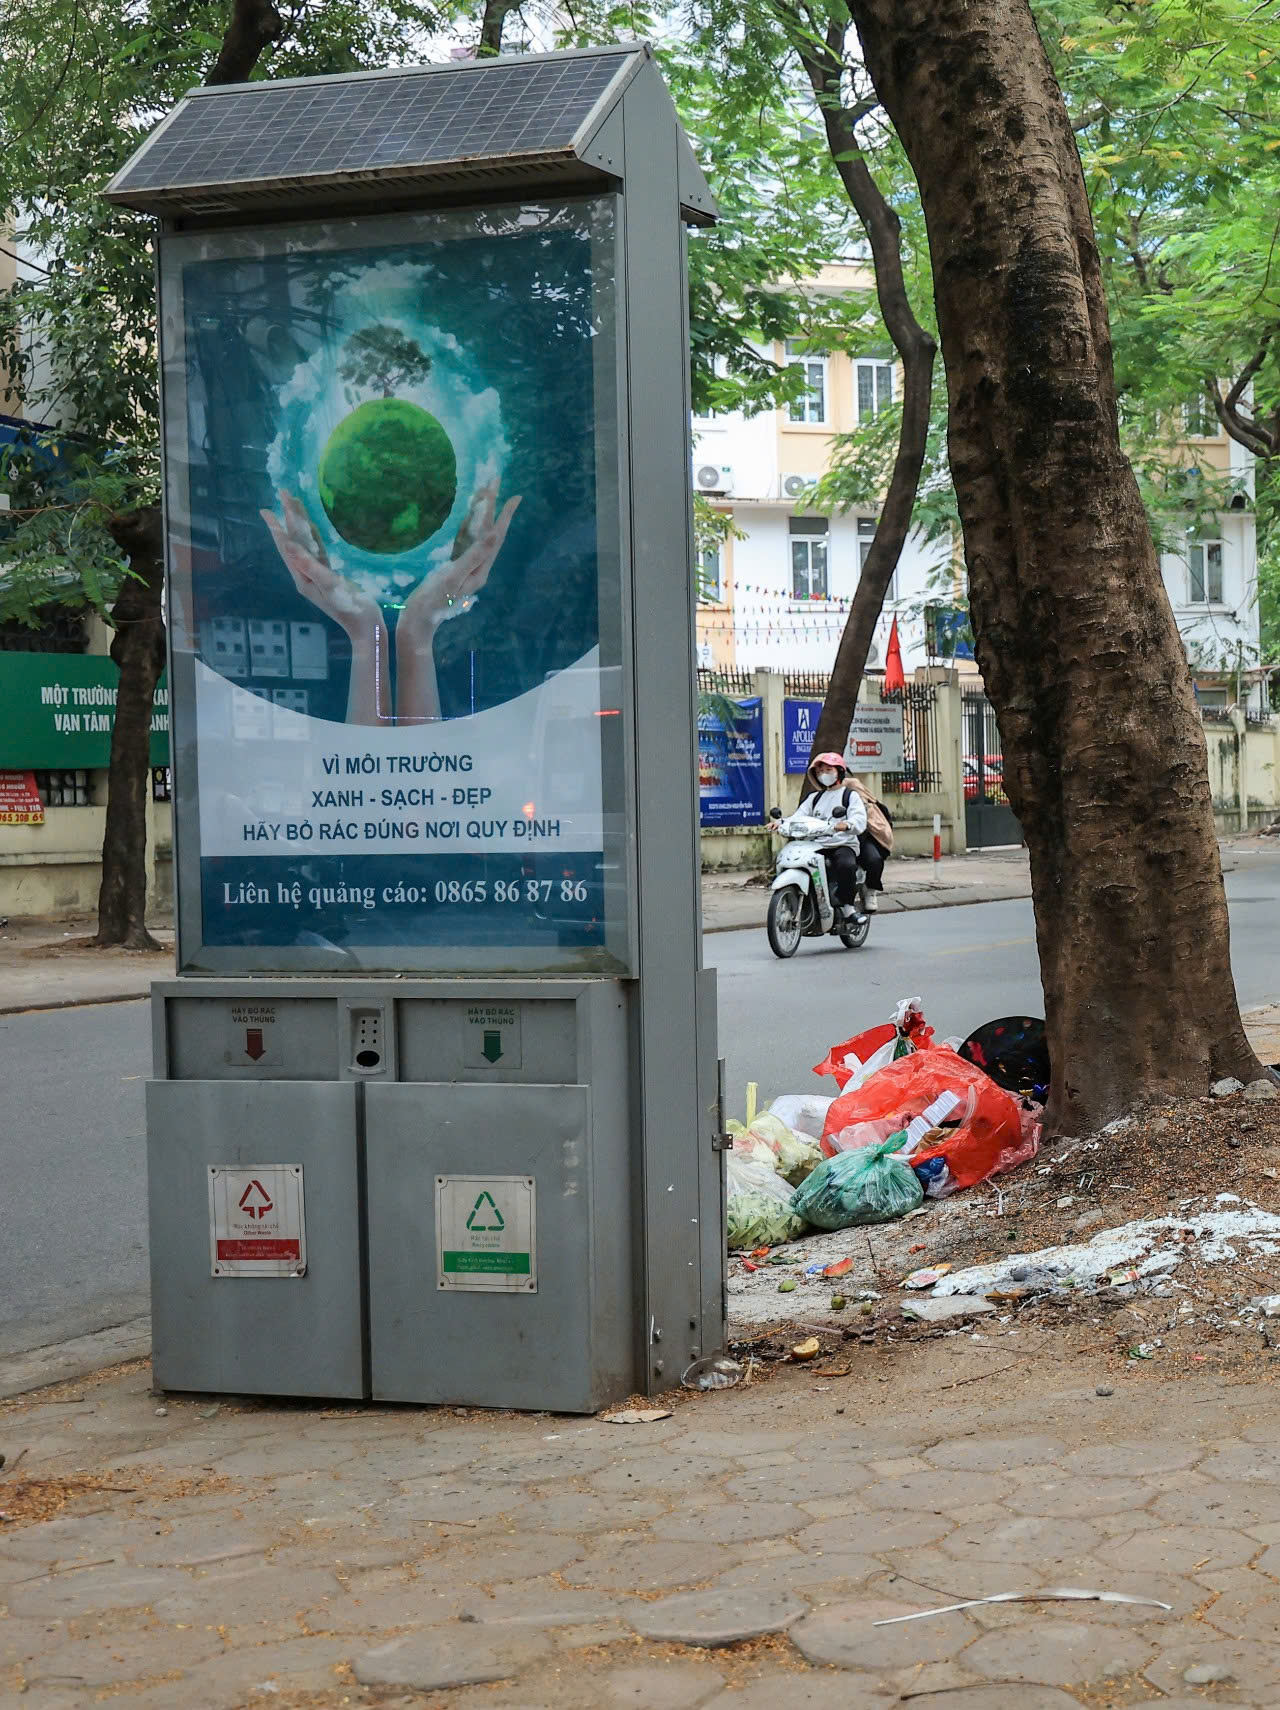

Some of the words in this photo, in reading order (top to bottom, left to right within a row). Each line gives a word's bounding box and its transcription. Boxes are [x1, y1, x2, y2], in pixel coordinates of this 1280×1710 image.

[41, 683, 69, 708] MỘT
[54, 713, 80, 735] VẠN
[83, 711, 110, 731] TÂM
[322, 754, 340, 775] VÌ
[346, 753, 380, 774] MÔI
[386, 751, 473, 773] TRƯỜNG
[312, 790, 363, 808] XANH
[381, 788, 434, 810] SẠCH
[452, 787, 492, 808] ĐẸP
[243, 821, 281, 841] HÃY
[286, 819, 313, 840] BỎ
[319, 819, 358, 840] RÁC
[364, 818, 419, 839] ĐÚNG
[426, 821, 460, 838] NƠI
[466, 820, 508, 839] QUY
[513, 819, 560, 841] ĐỊNH
[223, 881, 270, 904] Liên
[277, 881, 302, 909] hệ
[308, 881, 376, 909] quảng
[382, 881, 427, 903] cáo:
[435, 880, 487, 903] 0865
[494, 880, 520, 902] 86
[526, 880, 553, 902] 87
[560, 880, 587, 902] 86
